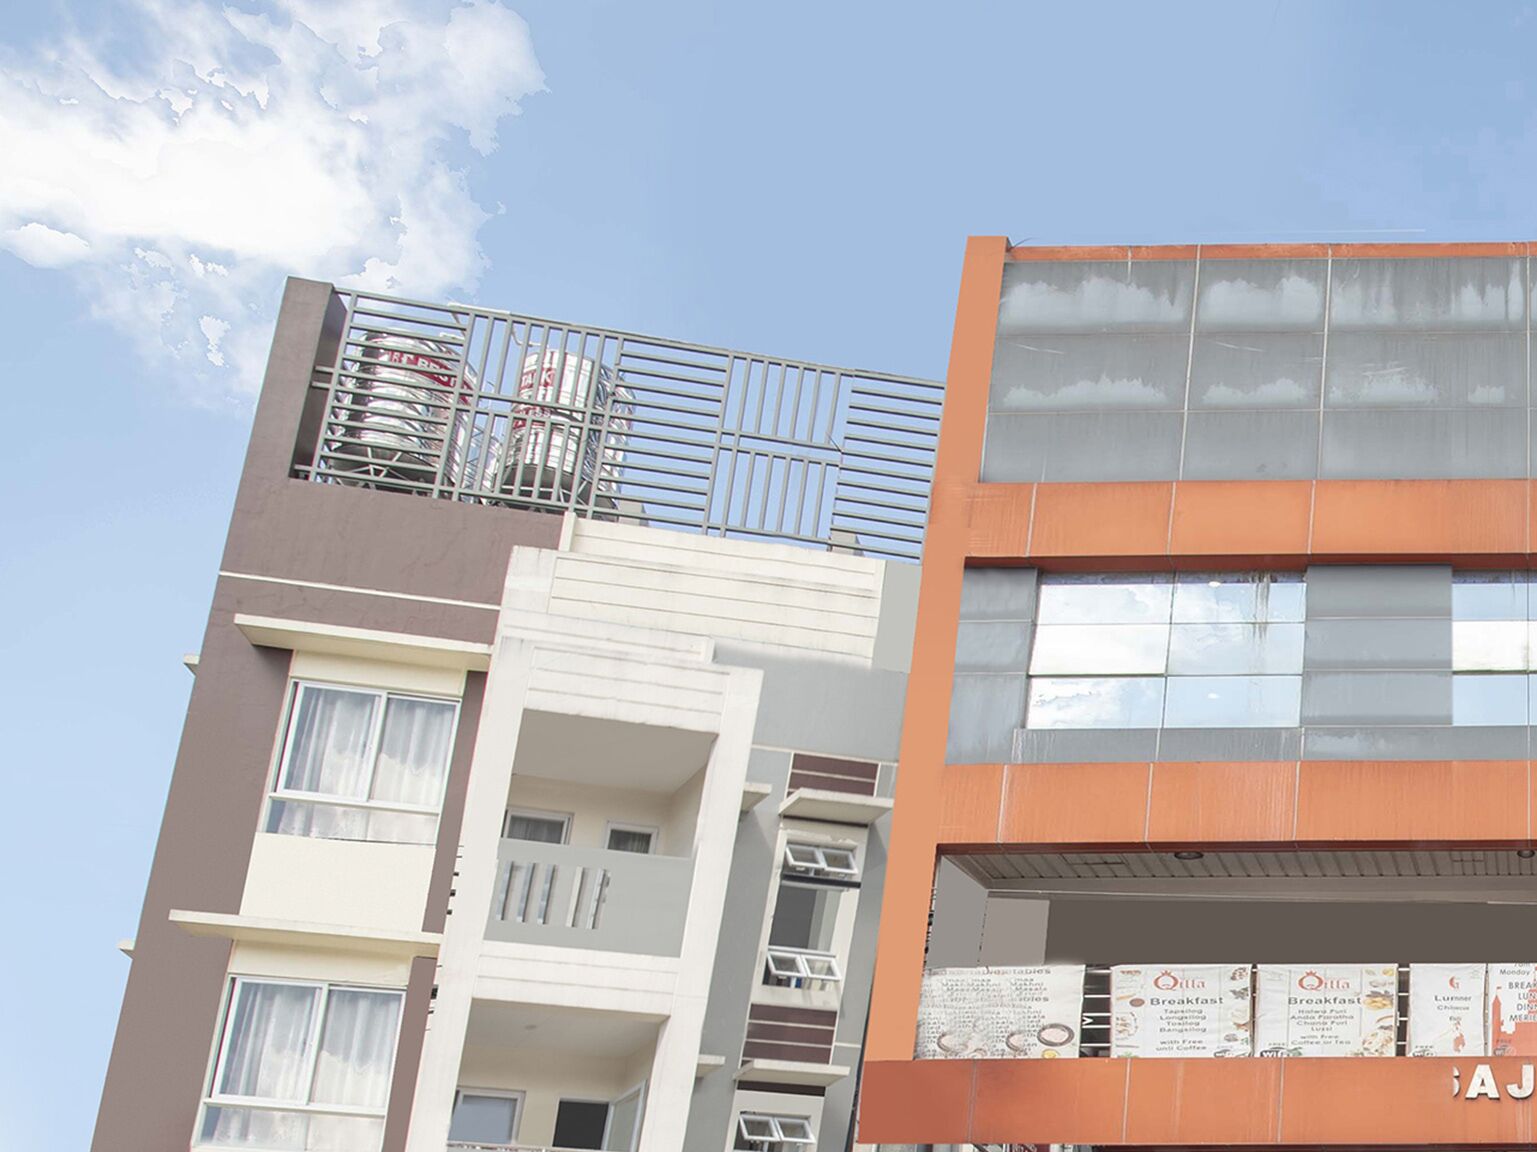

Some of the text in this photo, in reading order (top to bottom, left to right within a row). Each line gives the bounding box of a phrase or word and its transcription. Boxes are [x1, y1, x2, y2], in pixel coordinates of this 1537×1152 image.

[1499, 968, 1531, 977] Monday
[1153, 970, 1206, 991] Qilla
[1298, 970, 1351, 991] Qilla
[1149, 996, 1224, 1006] Breakfast
[1288, 996, 1362, 1006] Breakfast
